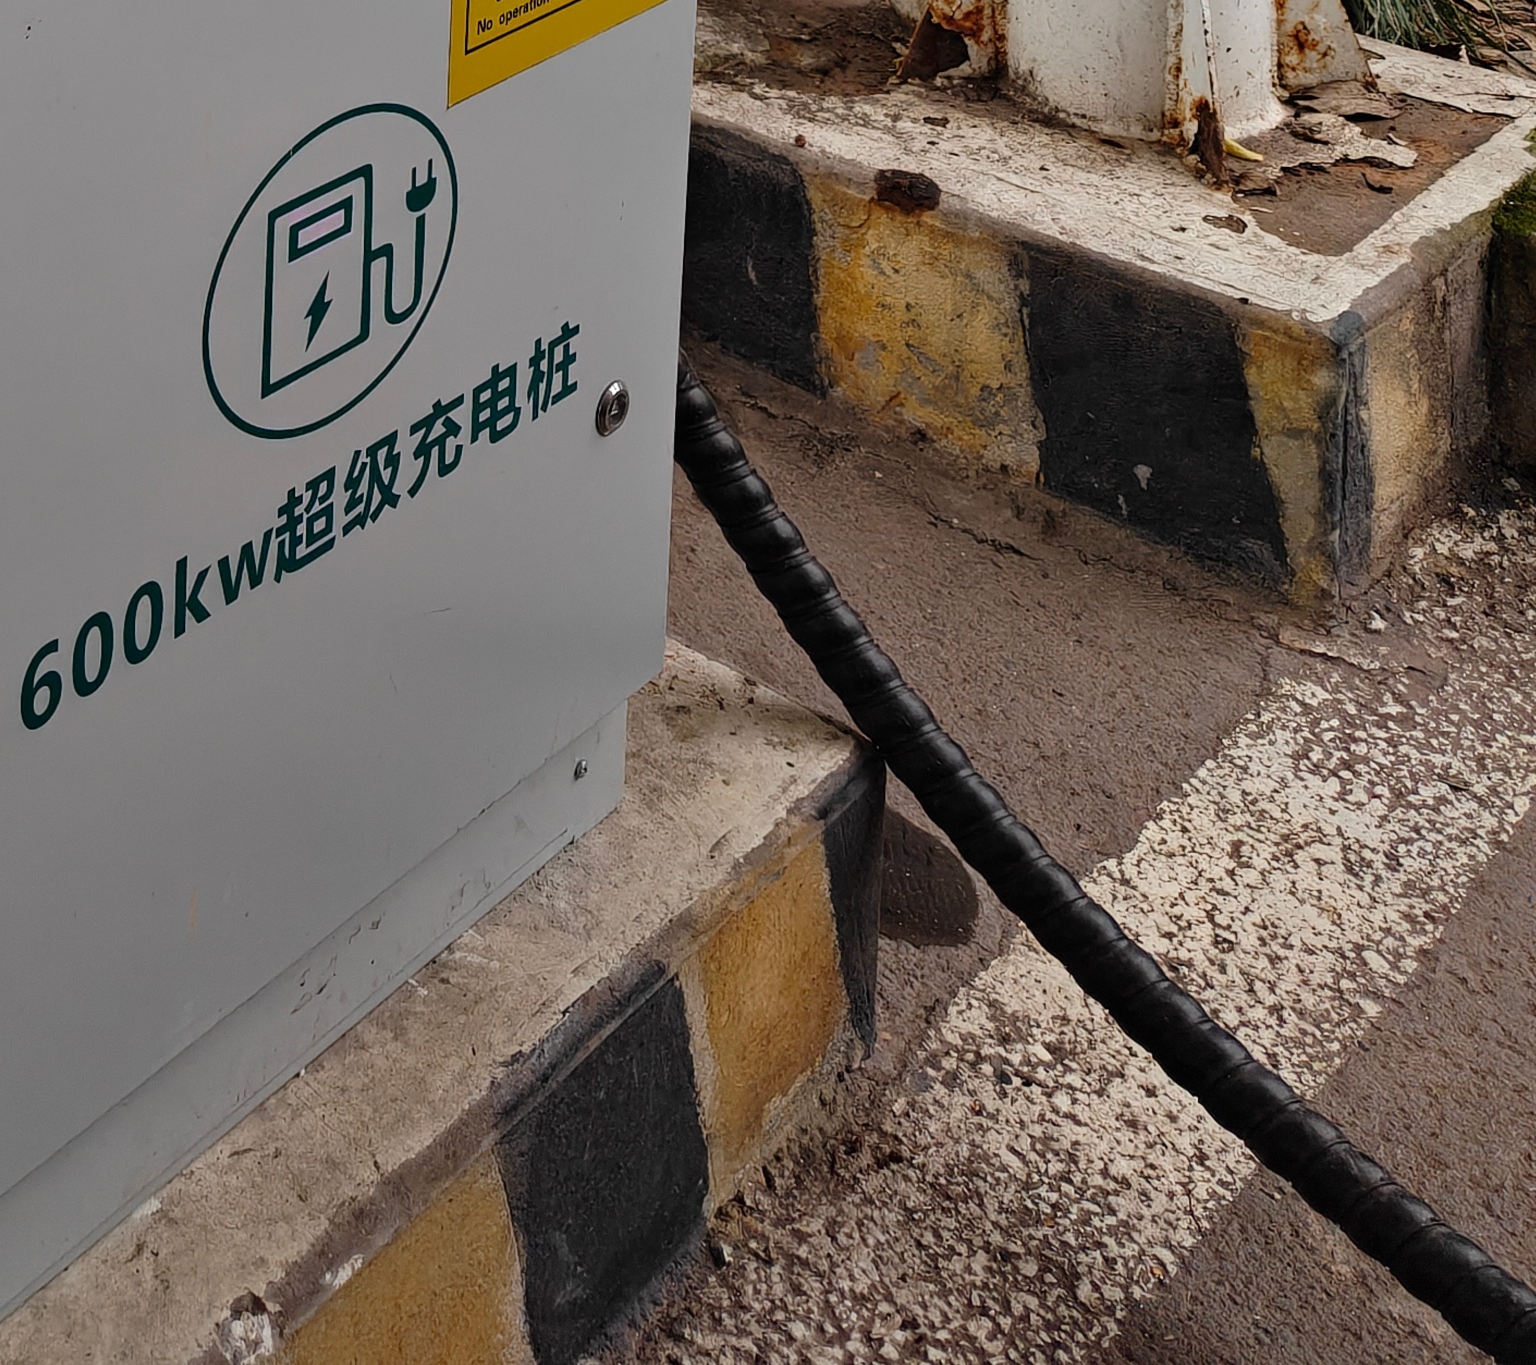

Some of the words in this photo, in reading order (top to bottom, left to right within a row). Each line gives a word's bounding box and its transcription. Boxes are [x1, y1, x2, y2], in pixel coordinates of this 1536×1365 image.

[477, 18, 493, 35] No
[19, 321, 581, 731] 600kw超级充电桩
